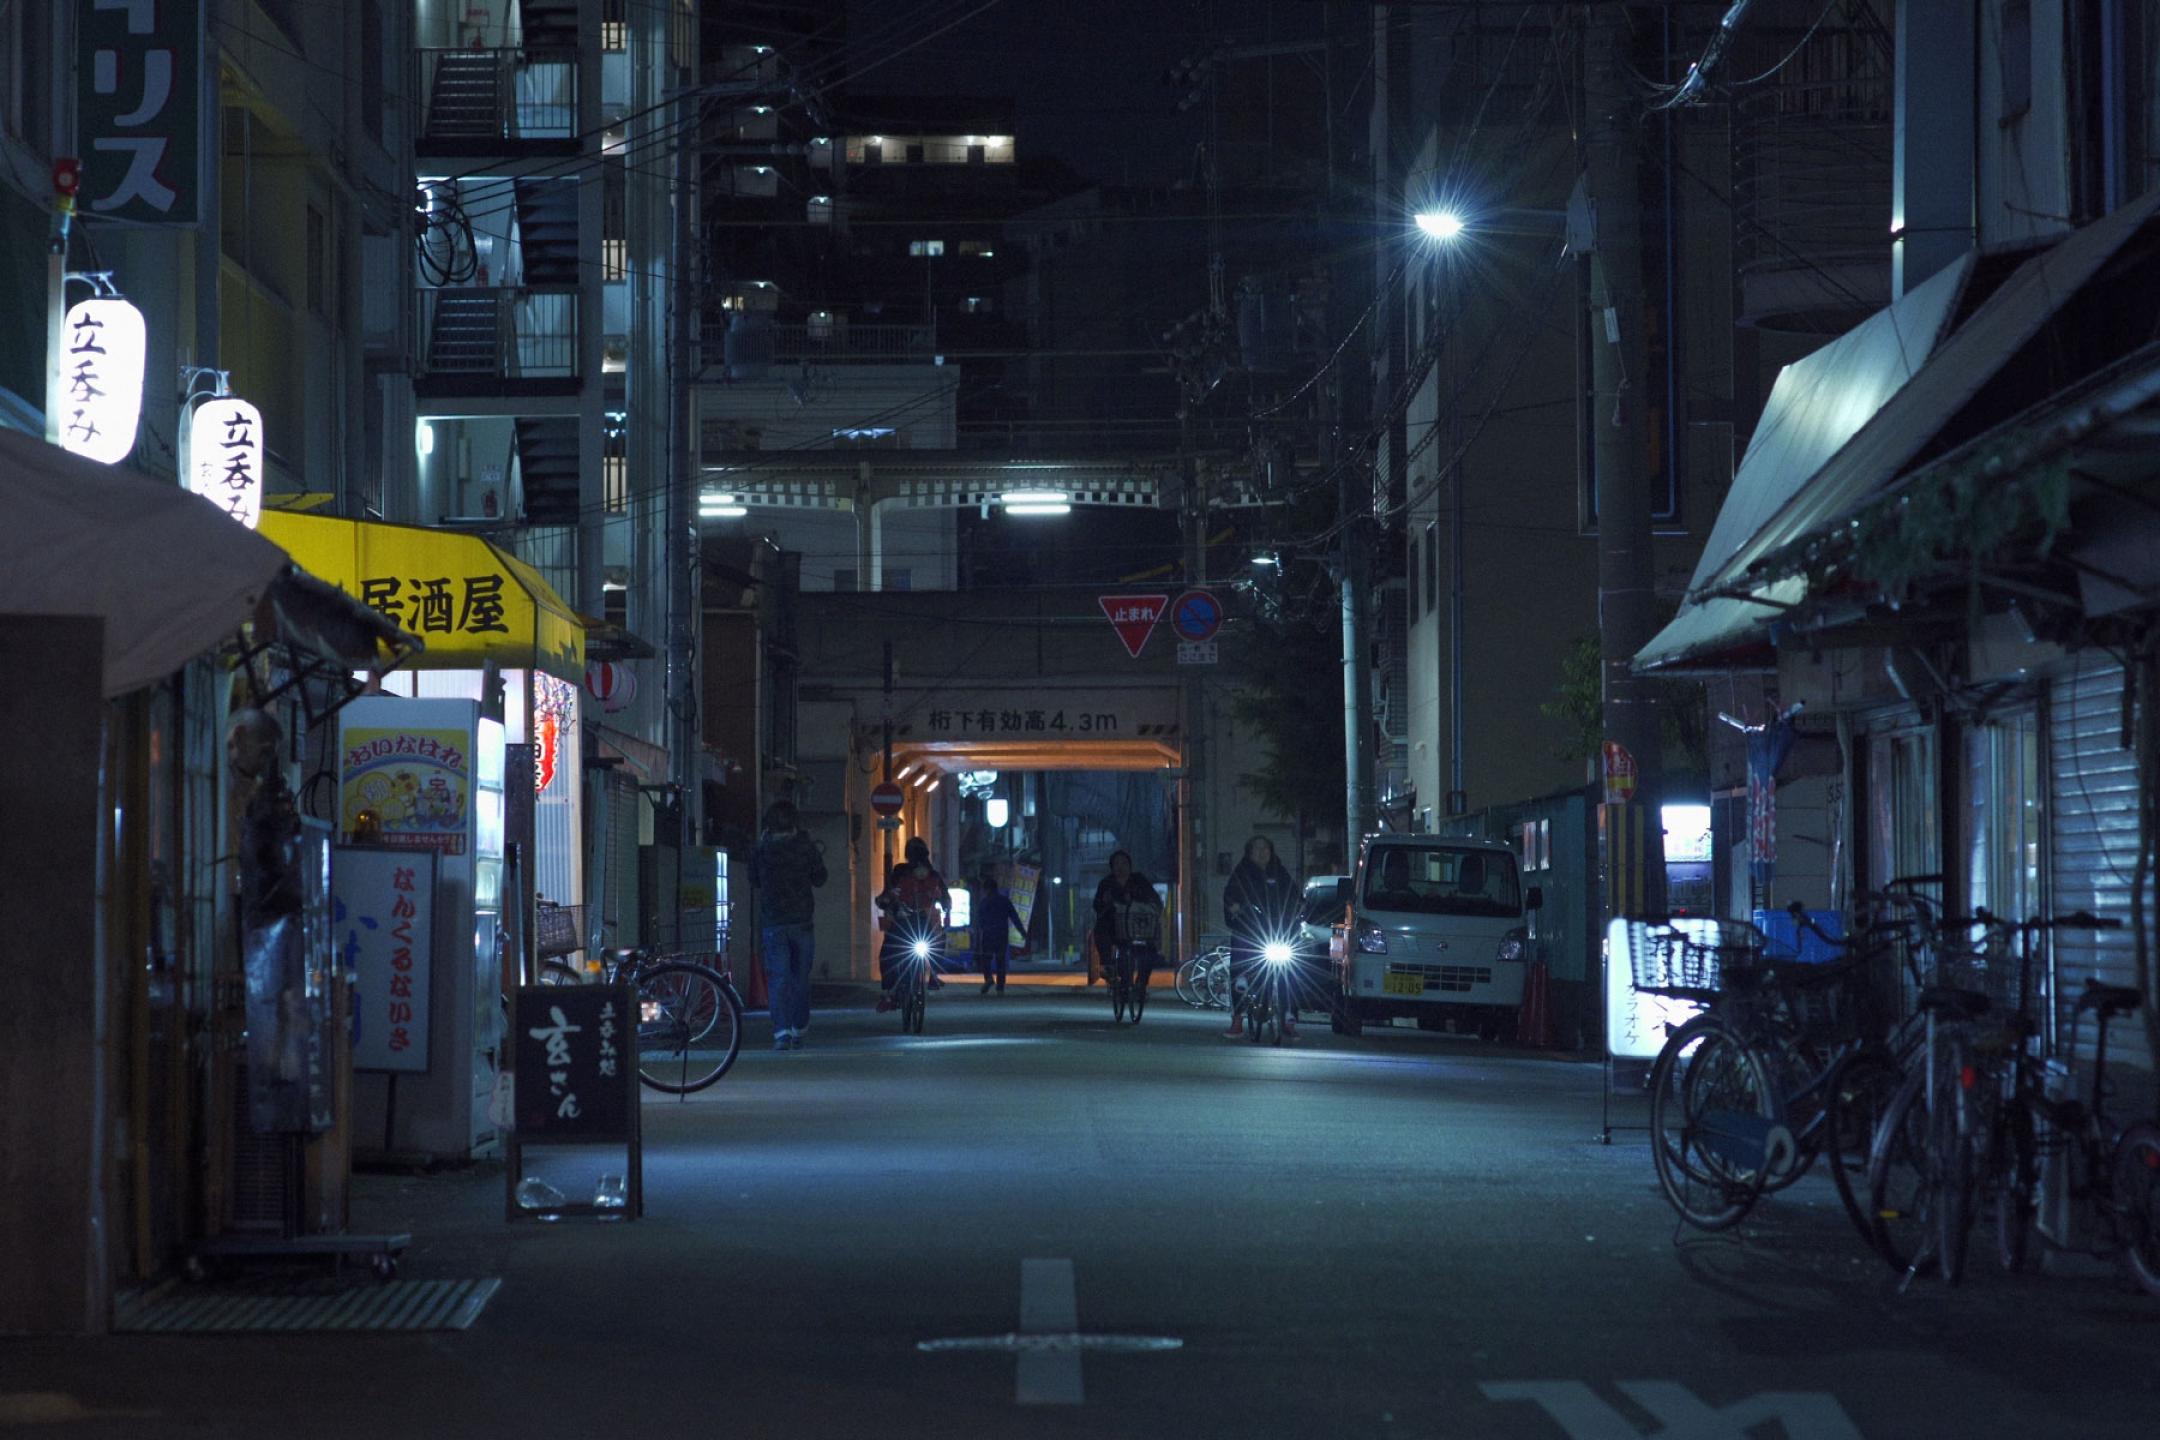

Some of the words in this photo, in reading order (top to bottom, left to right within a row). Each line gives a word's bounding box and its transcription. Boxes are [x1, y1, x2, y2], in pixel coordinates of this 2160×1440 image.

[67, 312, 107, 443] 立呑み
[360, 573, 510, 634] 居酒屋
[1114, 607, 1155, 622] 止まれ
[928, 709, 1118, 732] 桁下有効高4.3m
[388, 866, 417, 1053] なんくるないさ
[528, 1005, 582, 1119] 玄さん
